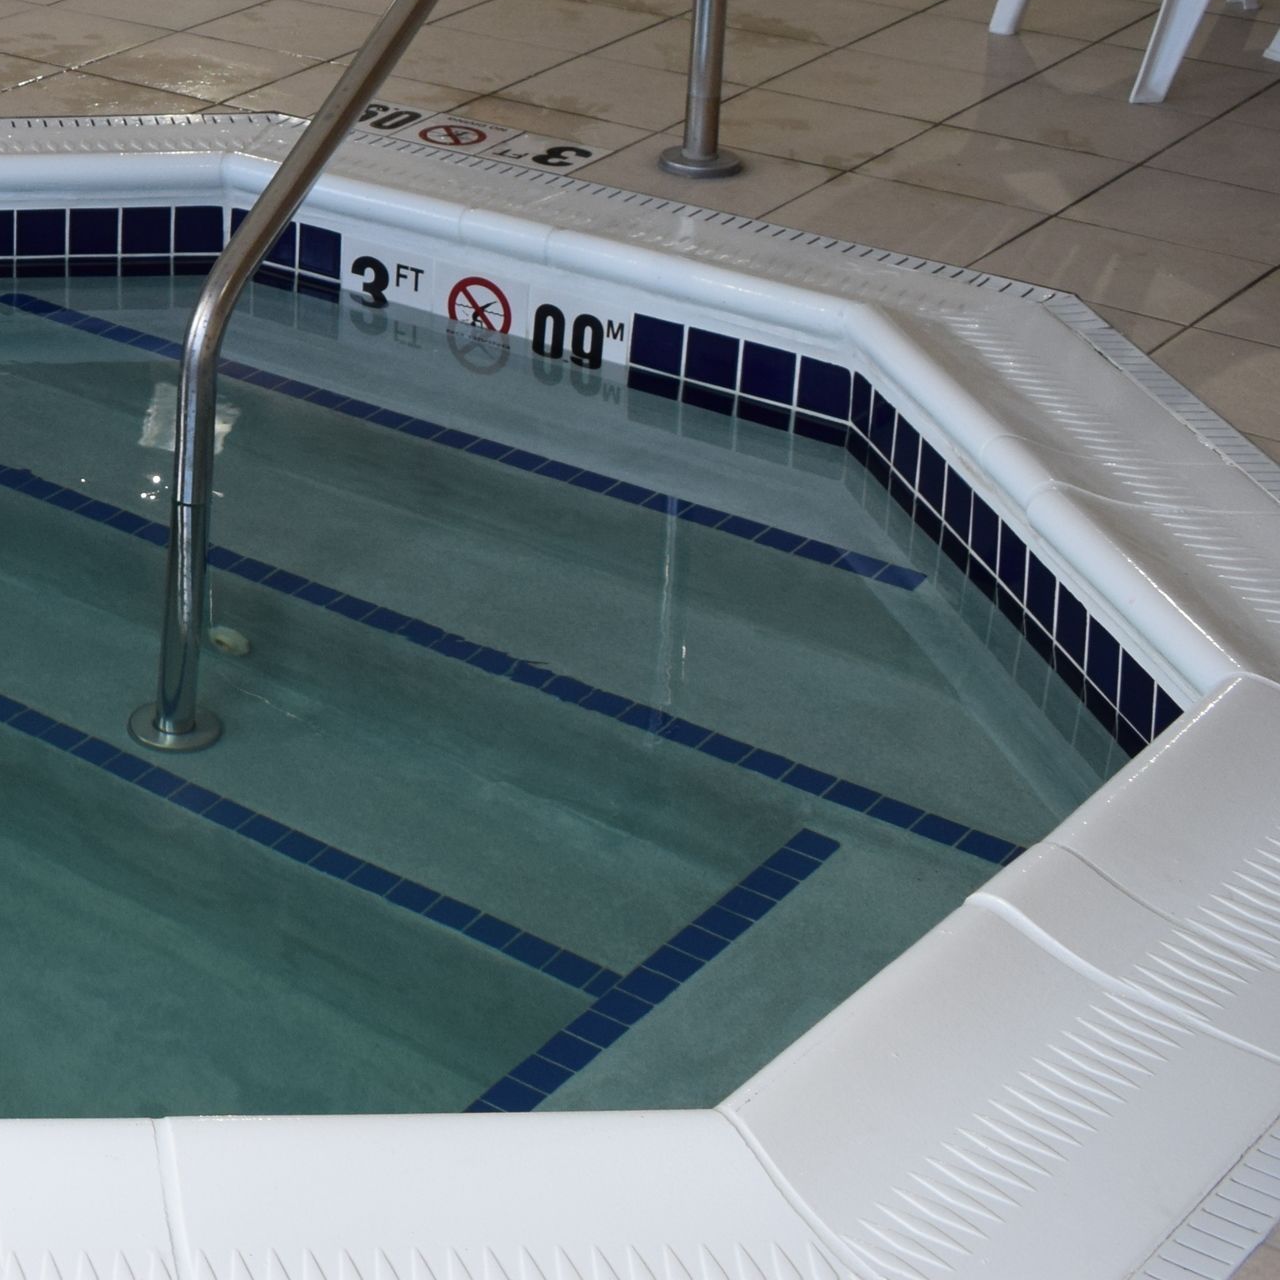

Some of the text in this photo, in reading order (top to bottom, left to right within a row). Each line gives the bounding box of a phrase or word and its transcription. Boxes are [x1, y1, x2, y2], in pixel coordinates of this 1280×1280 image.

[492, 146, 593, 167] 3 FT
[351, 255, 424, 309] 3 FT
[606, 319, 625, 343] M
